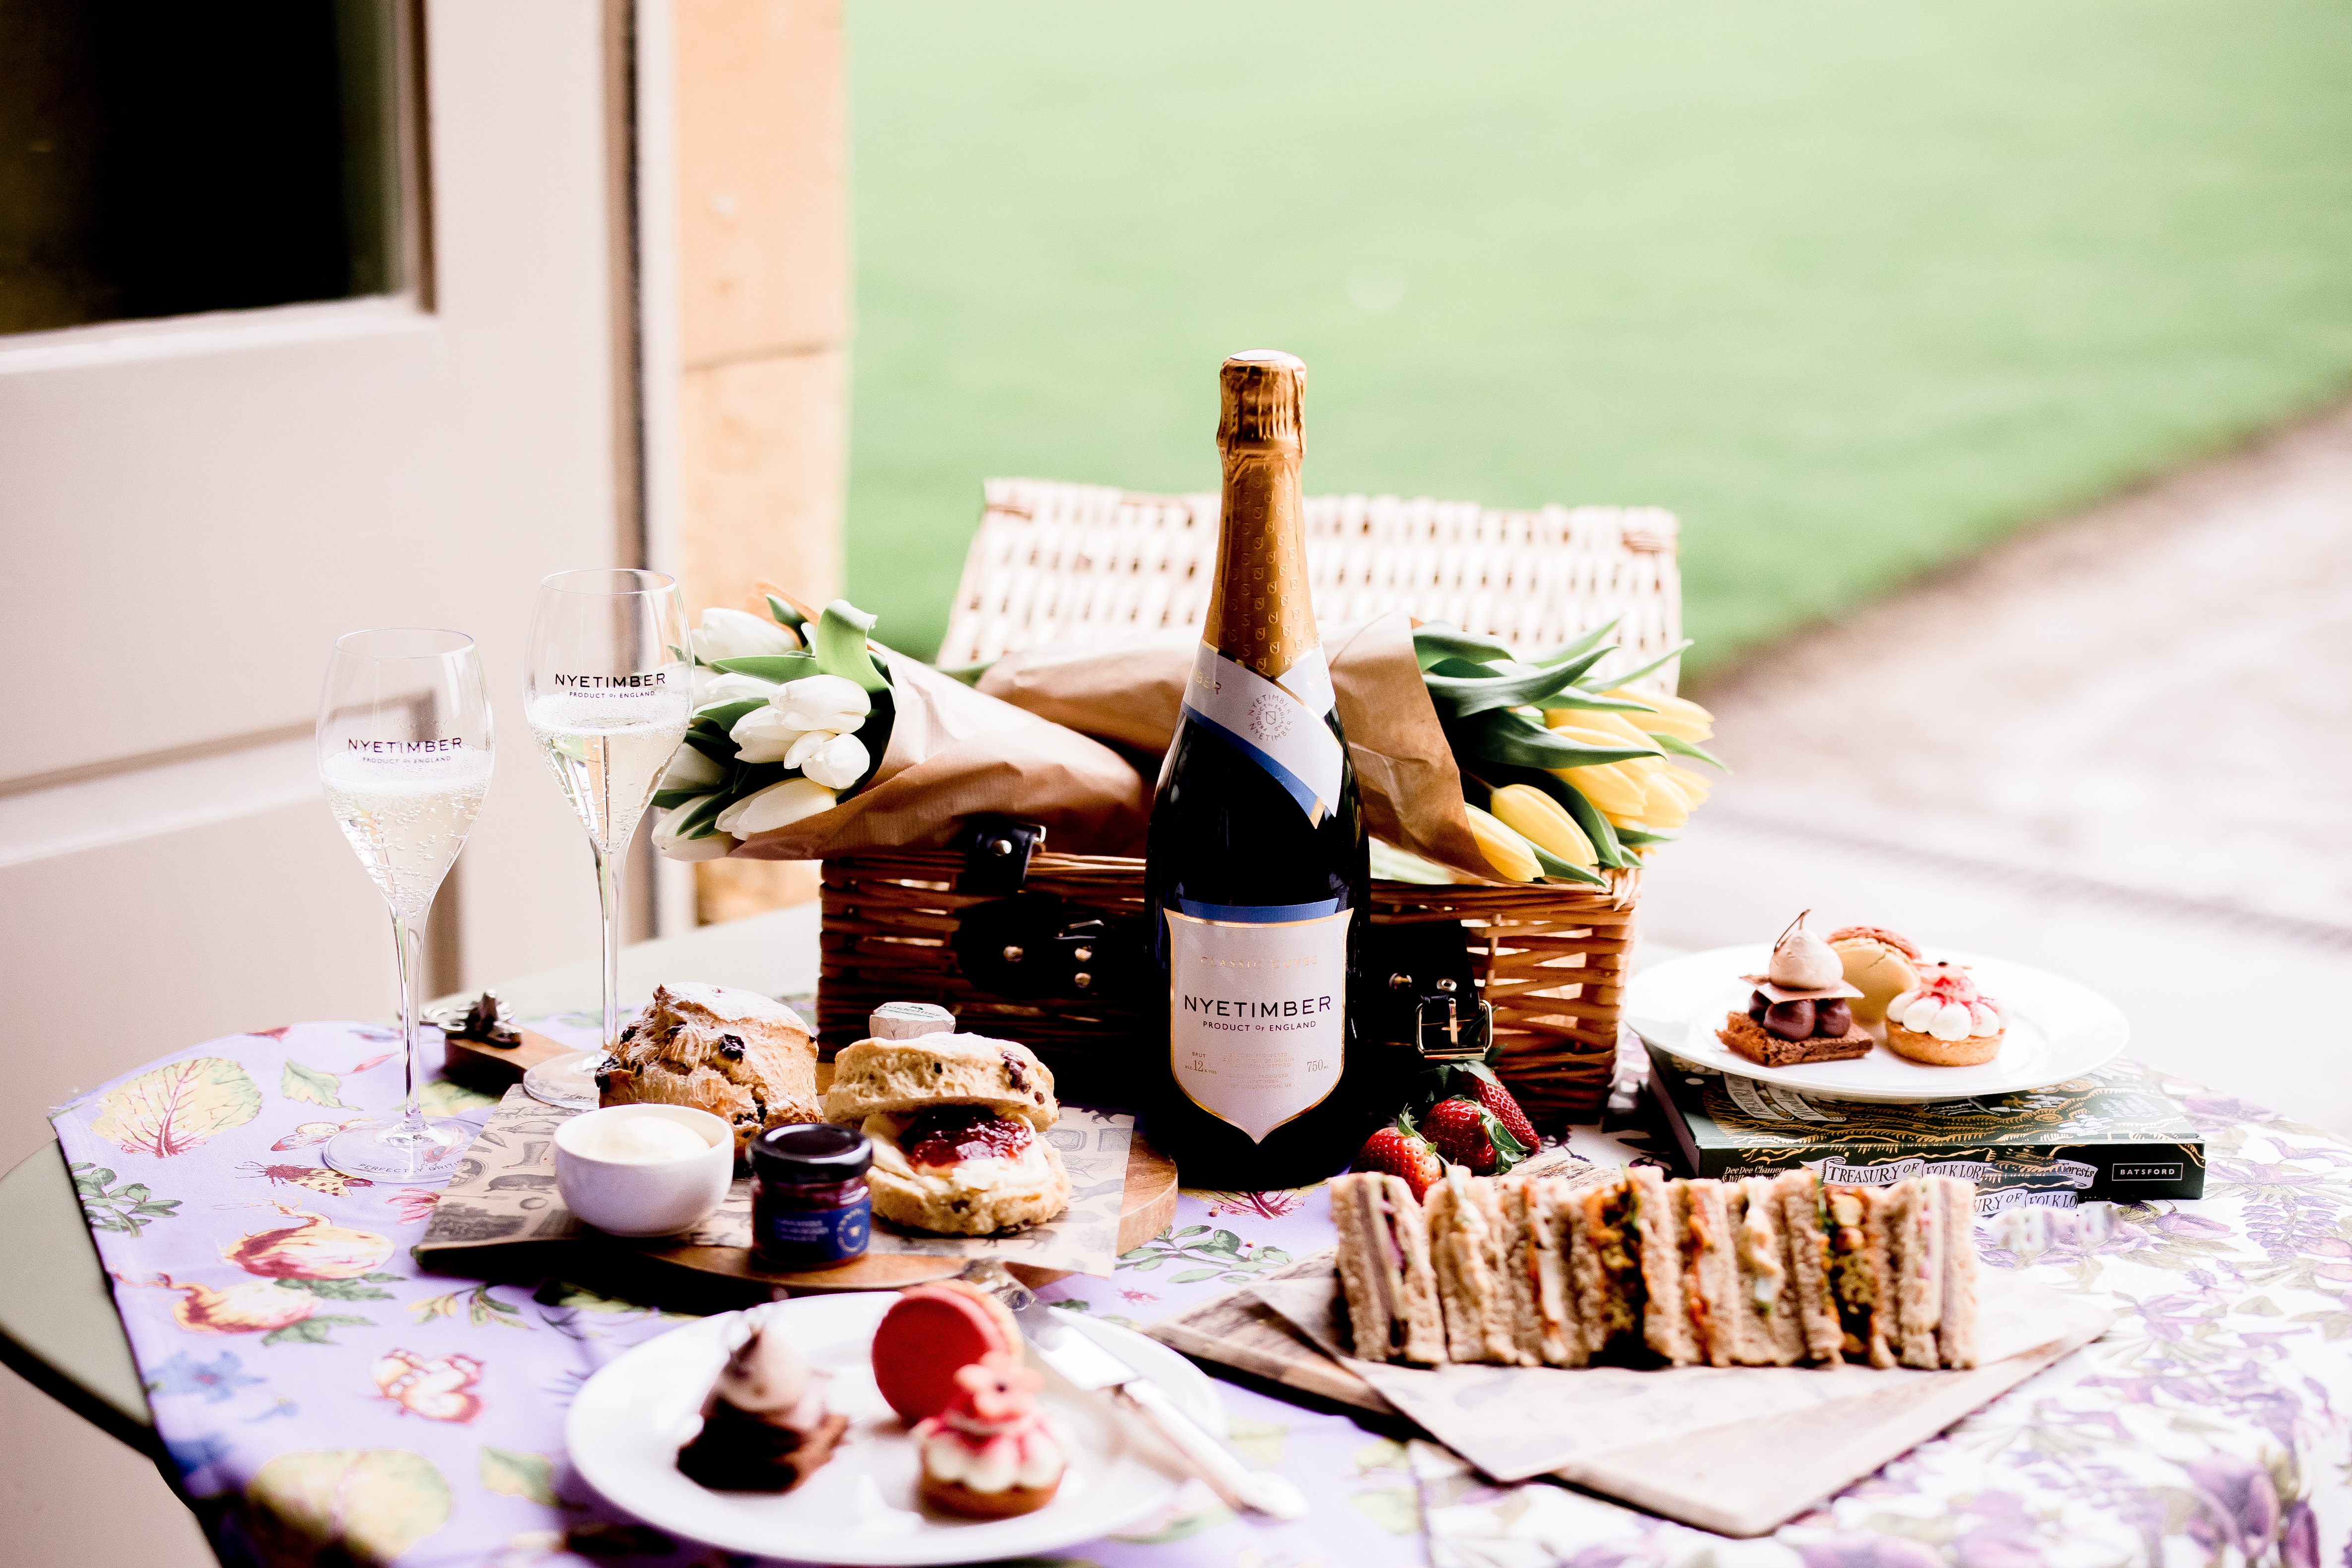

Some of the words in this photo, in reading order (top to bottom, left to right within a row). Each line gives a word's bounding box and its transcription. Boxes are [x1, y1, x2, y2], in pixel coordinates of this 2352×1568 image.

[555, 673, 665, 688] NYETIMBER
[1247, 694, 1292, 716] NYETIMBER
[1249, 720, 1293, 741] NYETIMBER
[348, 737, 462, 753] NYETIMBER
[1201, 956, 1262, 969] CLASSIC
[1184, 994, 1331, 1018] NYETIMBER
[1203, 1021, 1250, 1031] PRODUCT
[1269, 1021, 1316, 1031] ENGLAND
[1724, 1166, 1739, 1175] Dee
[1828, 1164, 1901, 1184] TREASURY
[1903, 1162, 1920, 1173] OF
